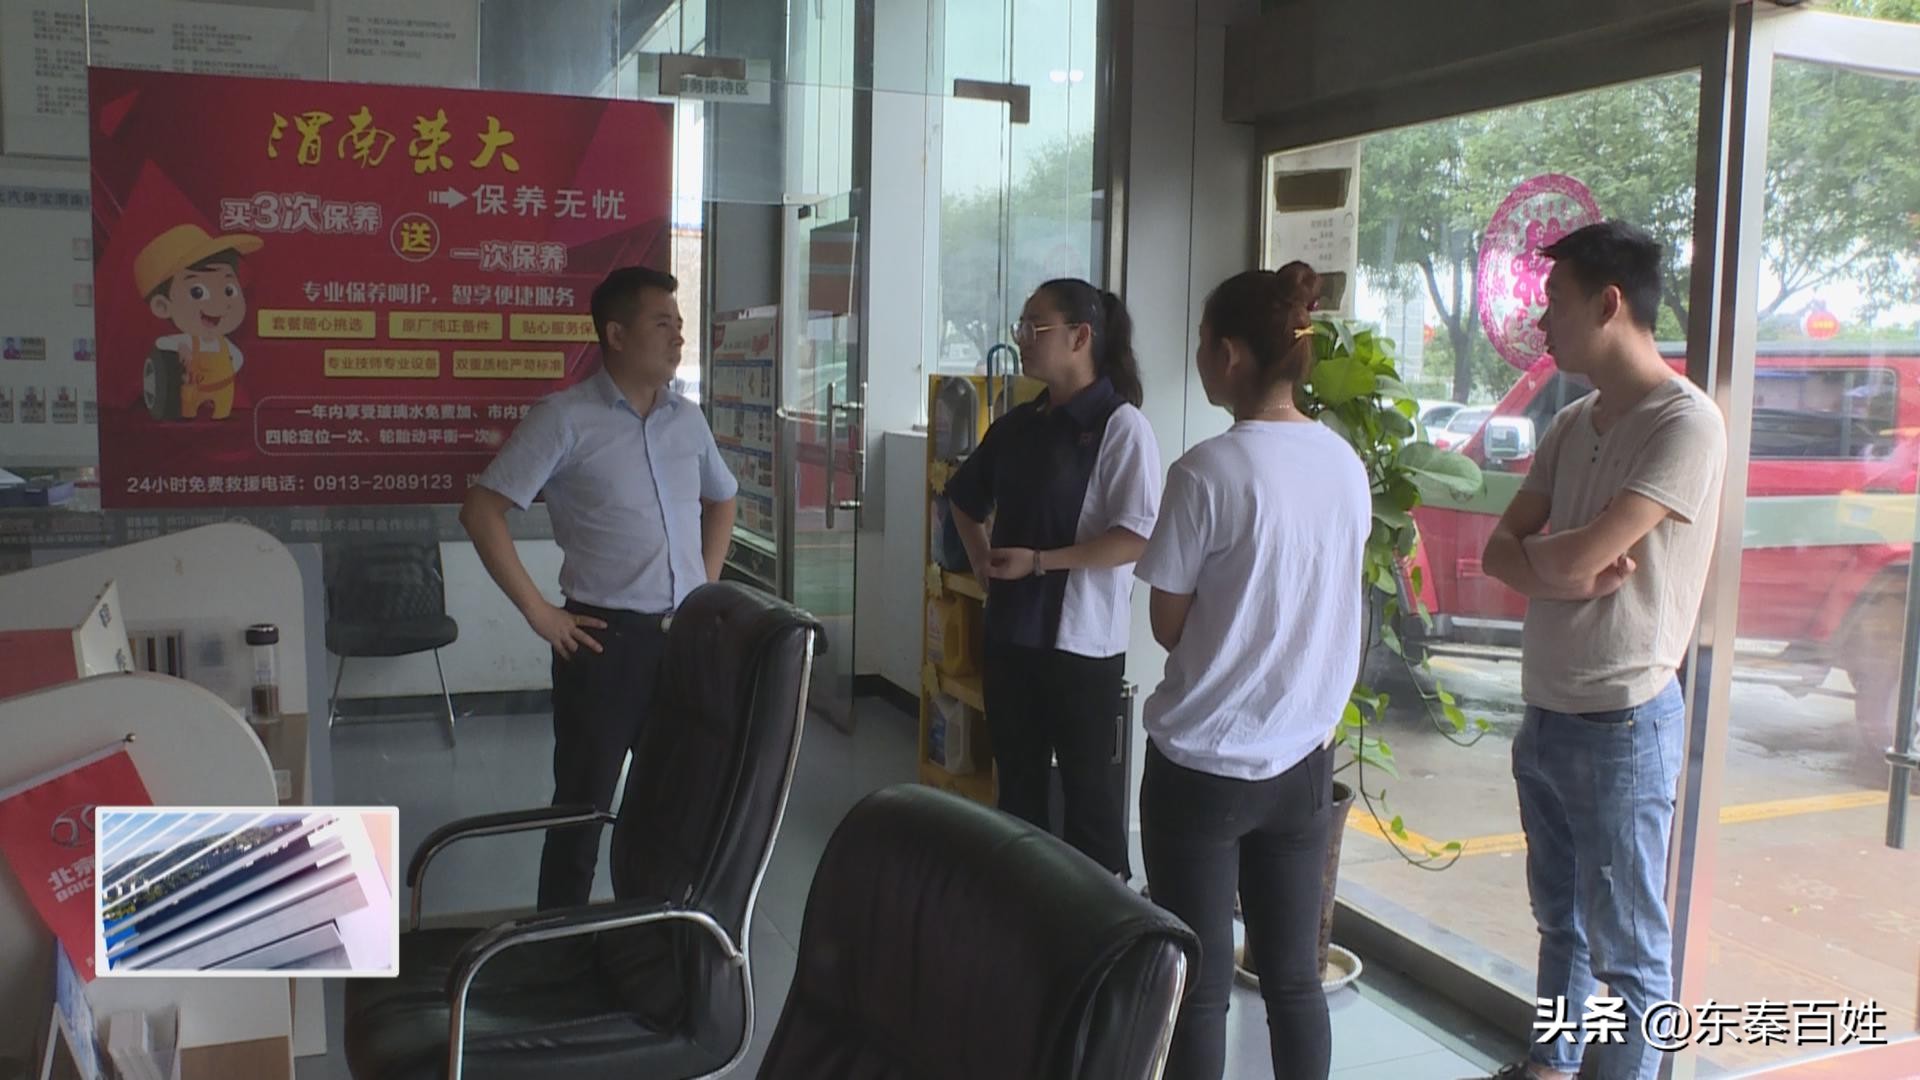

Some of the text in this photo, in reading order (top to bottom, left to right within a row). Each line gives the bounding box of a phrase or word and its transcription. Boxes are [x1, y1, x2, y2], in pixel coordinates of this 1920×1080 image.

[268, 106, 520, 173] 渭南荣大
[220, 194, 382, 234] 买3次保养
[472, 184, 626, 220] 保养无忧
[400, 222, 432, 253] 送
[450, 242, 568, 272] 一次保养
[271, 316, 363, 332] 套餐随心挑选
[402, 318, 490, 334] 原厂纯正备件
[328, 356, 437, 371] 专业技师专业设备
